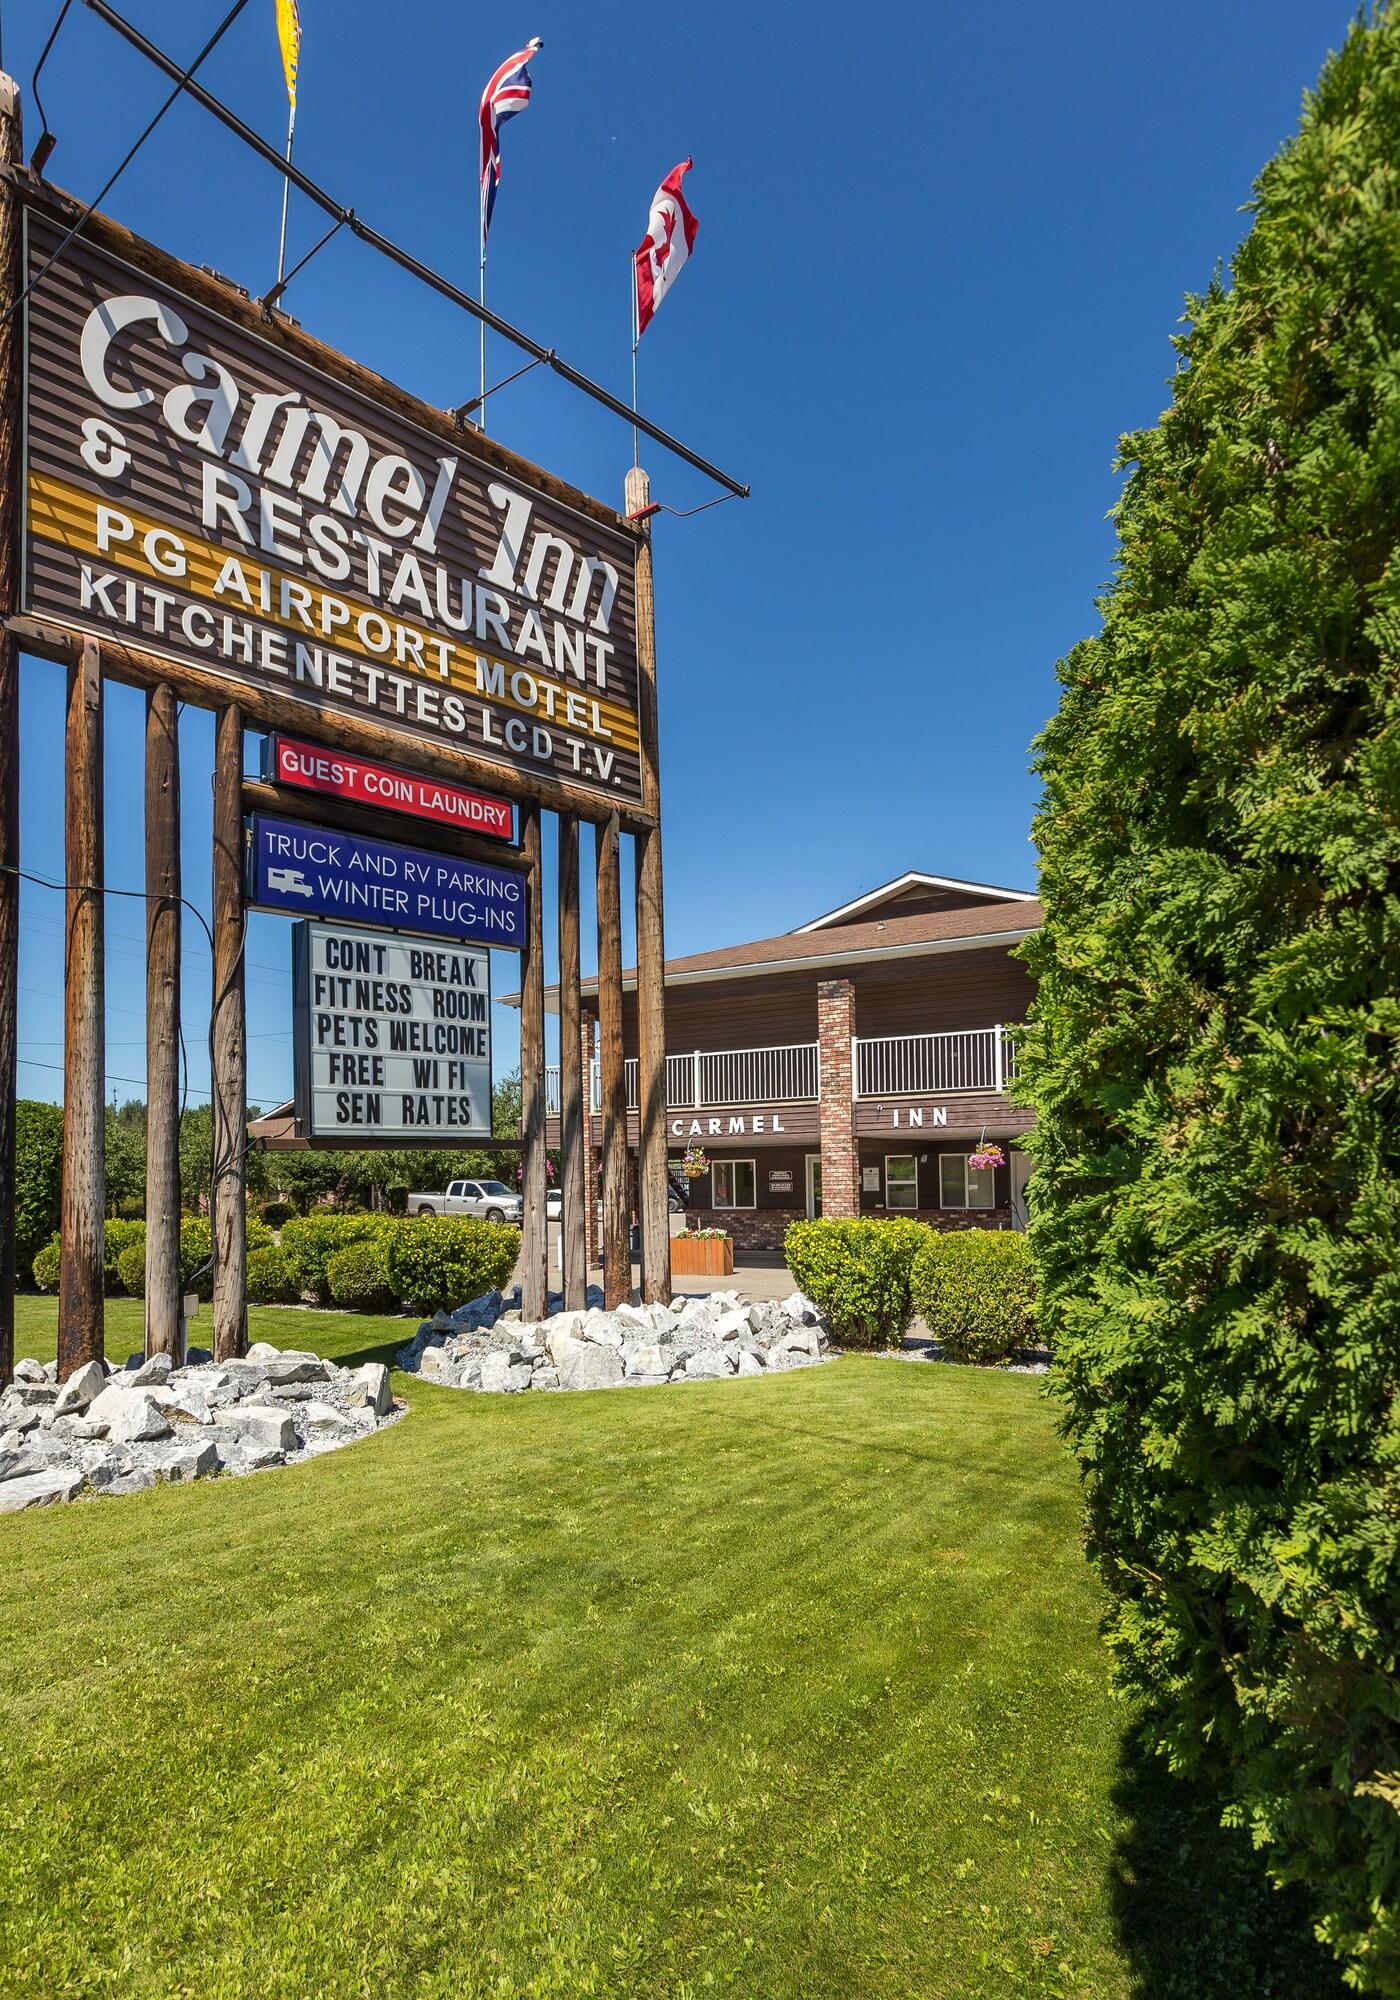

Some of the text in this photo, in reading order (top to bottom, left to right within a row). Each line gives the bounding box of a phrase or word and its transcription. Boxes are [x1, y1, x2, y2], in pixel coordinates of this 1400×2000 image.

[80, 295, 620, 633] Carmel Inn
[80, 417, 614, 689] & RESTAURANT
[96, 504, 612, 737] PG AIRPORT MOTEL
[80, 564, 622, 785] KITCHENETTES LCD T.V.
[281, 750, 507, 826] GUEST COIN LAUNDRY
[266, 832, 520, 902] TRUCK AND RV PARKING
[318, 875, 516, 933] WINTER PLUG-INS
[325, 937, 476, 987] CONT BREAK
[314, 974, 486, 1022] FITNESS ROOM
[318, 1014, 487, 1057] PETS WELCOME
[329, 1053, 384, 1086] FREE
[336, 1092, 470, 1126] SEN RATES
[671, 1107, 948, 1137] CARMEL INN
